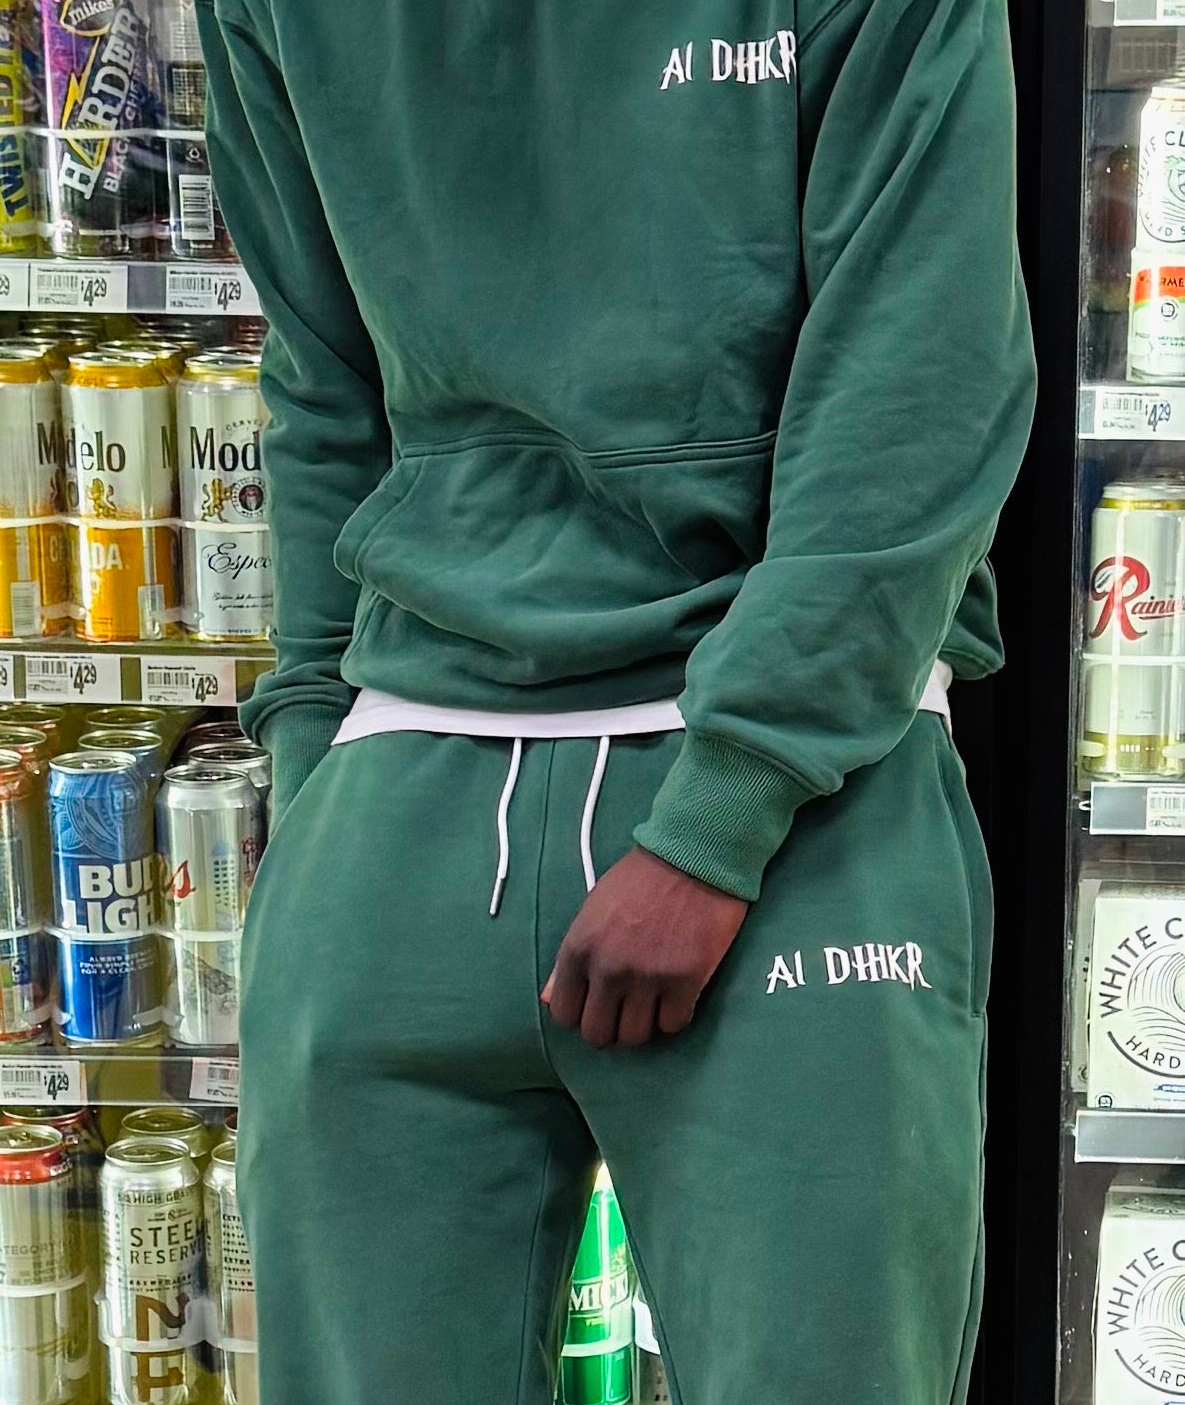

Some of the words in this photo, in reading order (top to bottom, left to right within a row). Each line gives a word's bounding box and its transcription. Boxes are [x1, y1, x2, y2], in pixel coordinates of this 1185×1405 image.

[1099, 925, 1158, 1018] WHITE
[1126, 1035, 1182, 1069] HARD
[1107, 1247, 1164, 1336] WHITE
